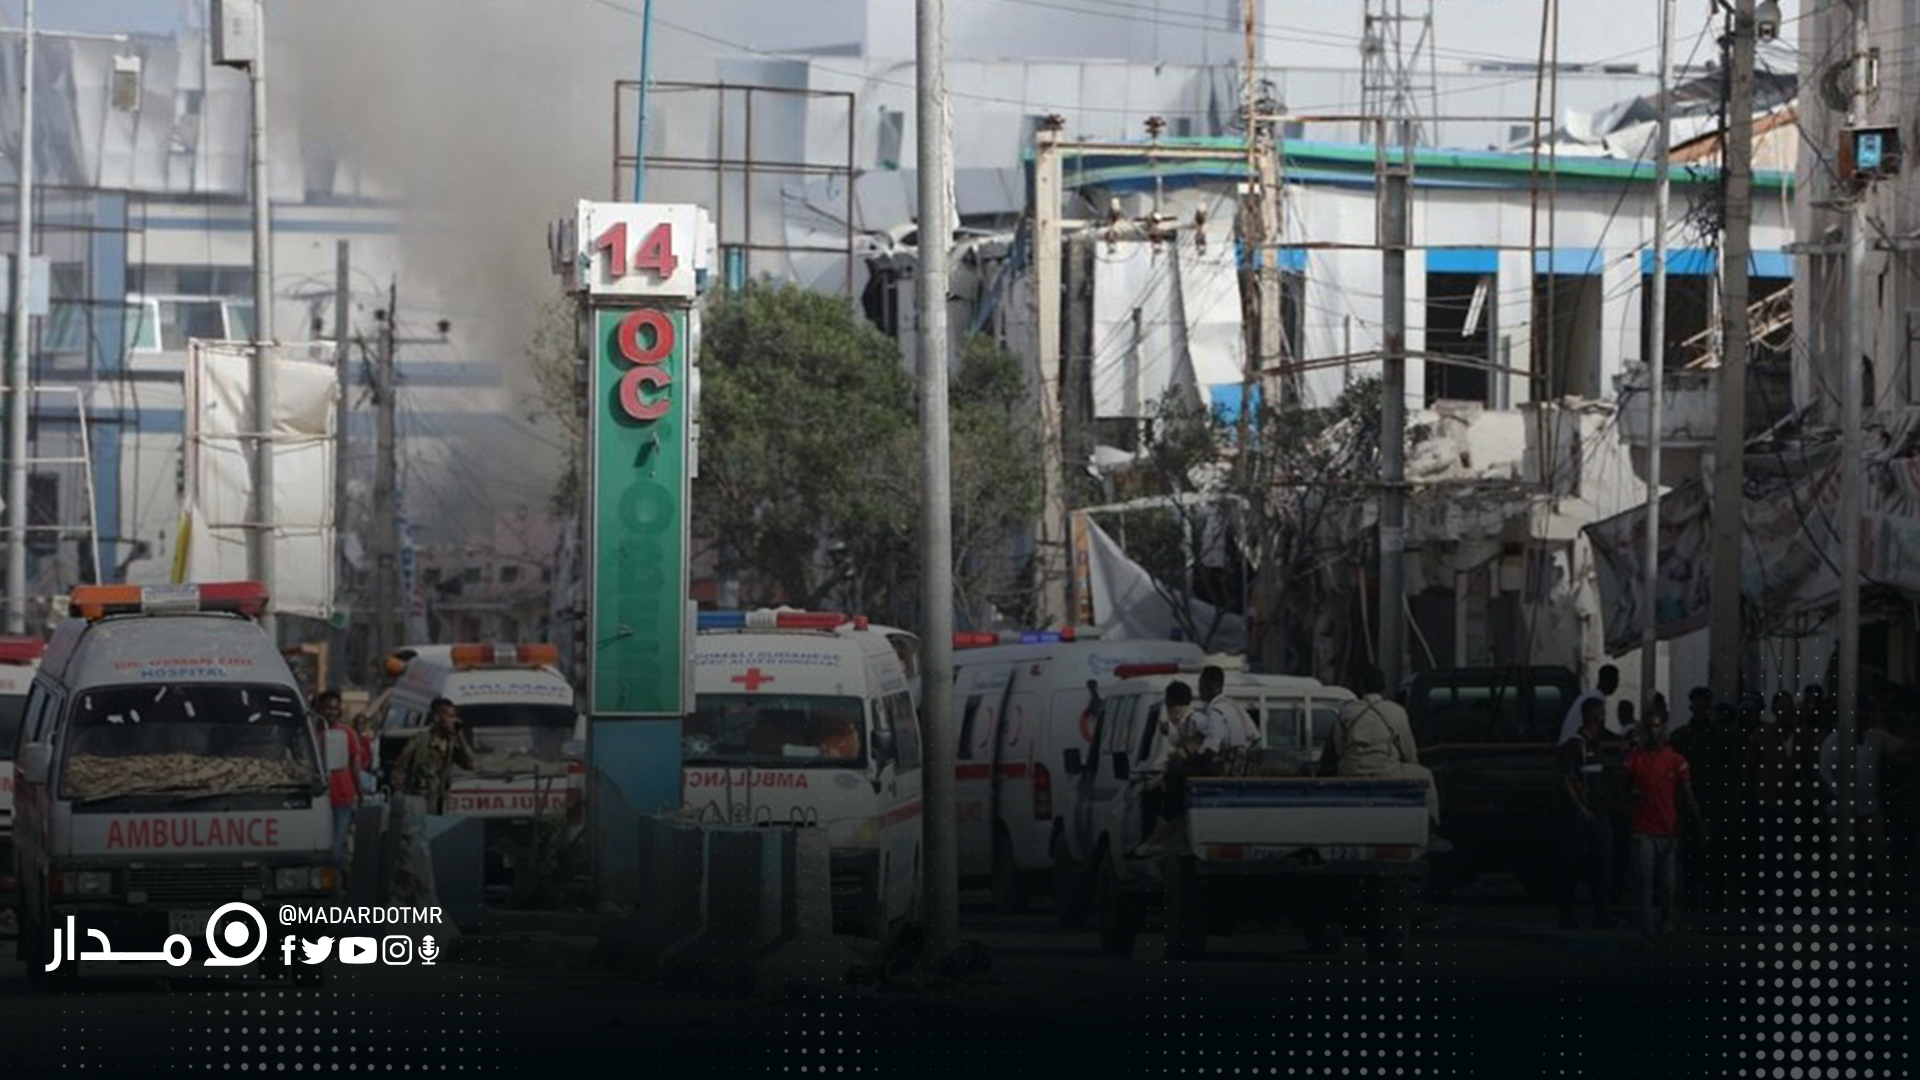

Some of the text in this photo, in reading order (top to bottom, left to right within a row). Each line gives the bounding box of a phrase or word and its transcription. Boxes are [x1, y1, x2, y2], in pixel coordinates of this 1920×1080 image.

[593, 222, 678, 280] 14
[141, 668, 227, 679] HOSPITAL
[107, 817, 280, 849] AMBULANCE
